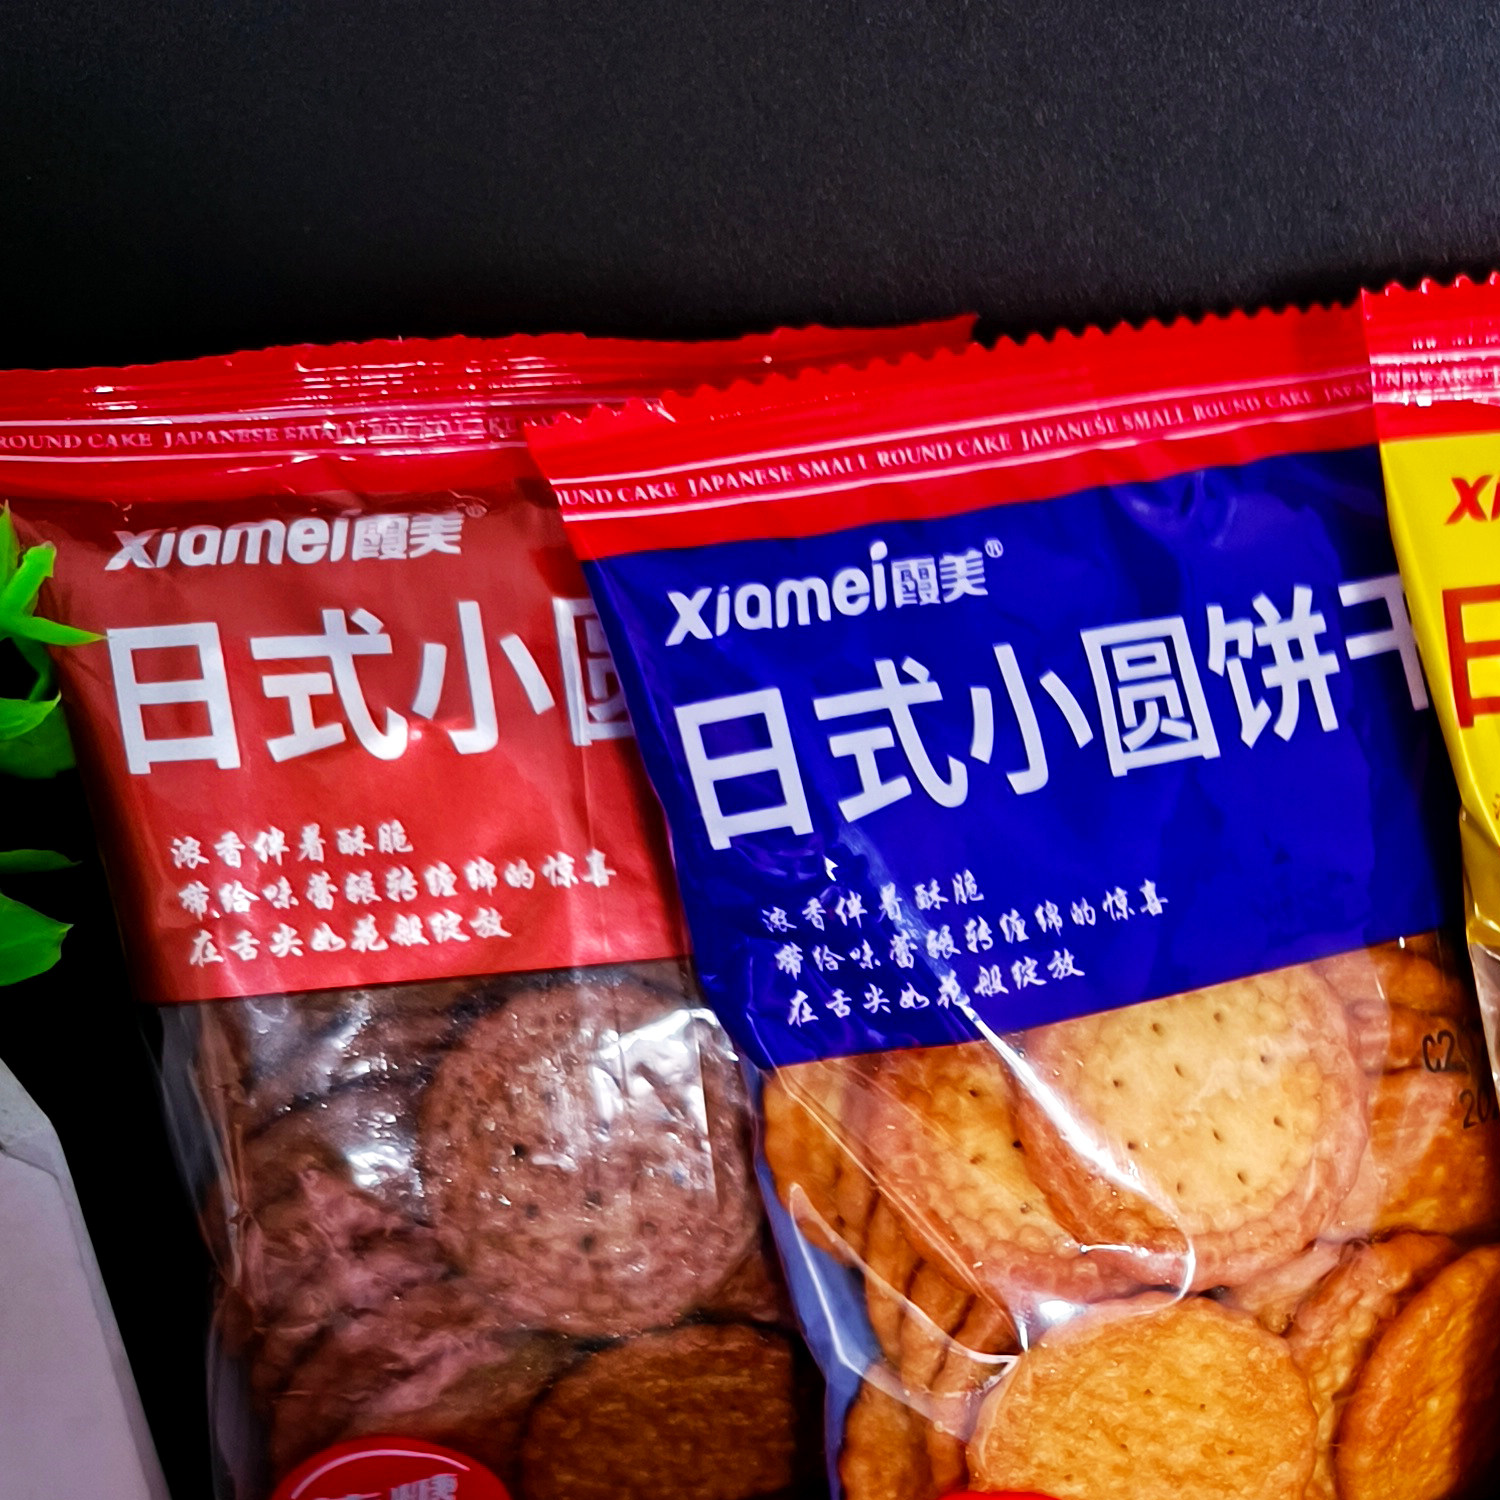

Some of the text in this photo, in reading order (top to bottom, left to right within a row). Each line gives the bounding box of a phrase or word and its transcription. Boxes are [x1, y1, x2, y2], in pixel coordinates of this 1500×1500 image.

[88, 432, 153, 449] CAKE
[163, 426, 280, 448] JAPANESE
[284, 420, 365, 442] SMALL
[617, 481, 678, 503] CAKE
[687, 464, 792, 497] JAPANESE
[797, 453, 874, 480] SMALL
[877, 442, 953, 469] ROUND
[956, 432, 1013, 457] CAKE
[1019, 415, 1119, 451] JAPANESE
[1122, 404, 1191, 432] SMALL
[1192, 394, 1261, 422] ROUND
[170, 818, 414, 870] 浓香伴着酥脆
[761, 868, 985, 934] 浓香伴着酥脆
[189, 906, 512, 967] 在舌尖如花般绽放
